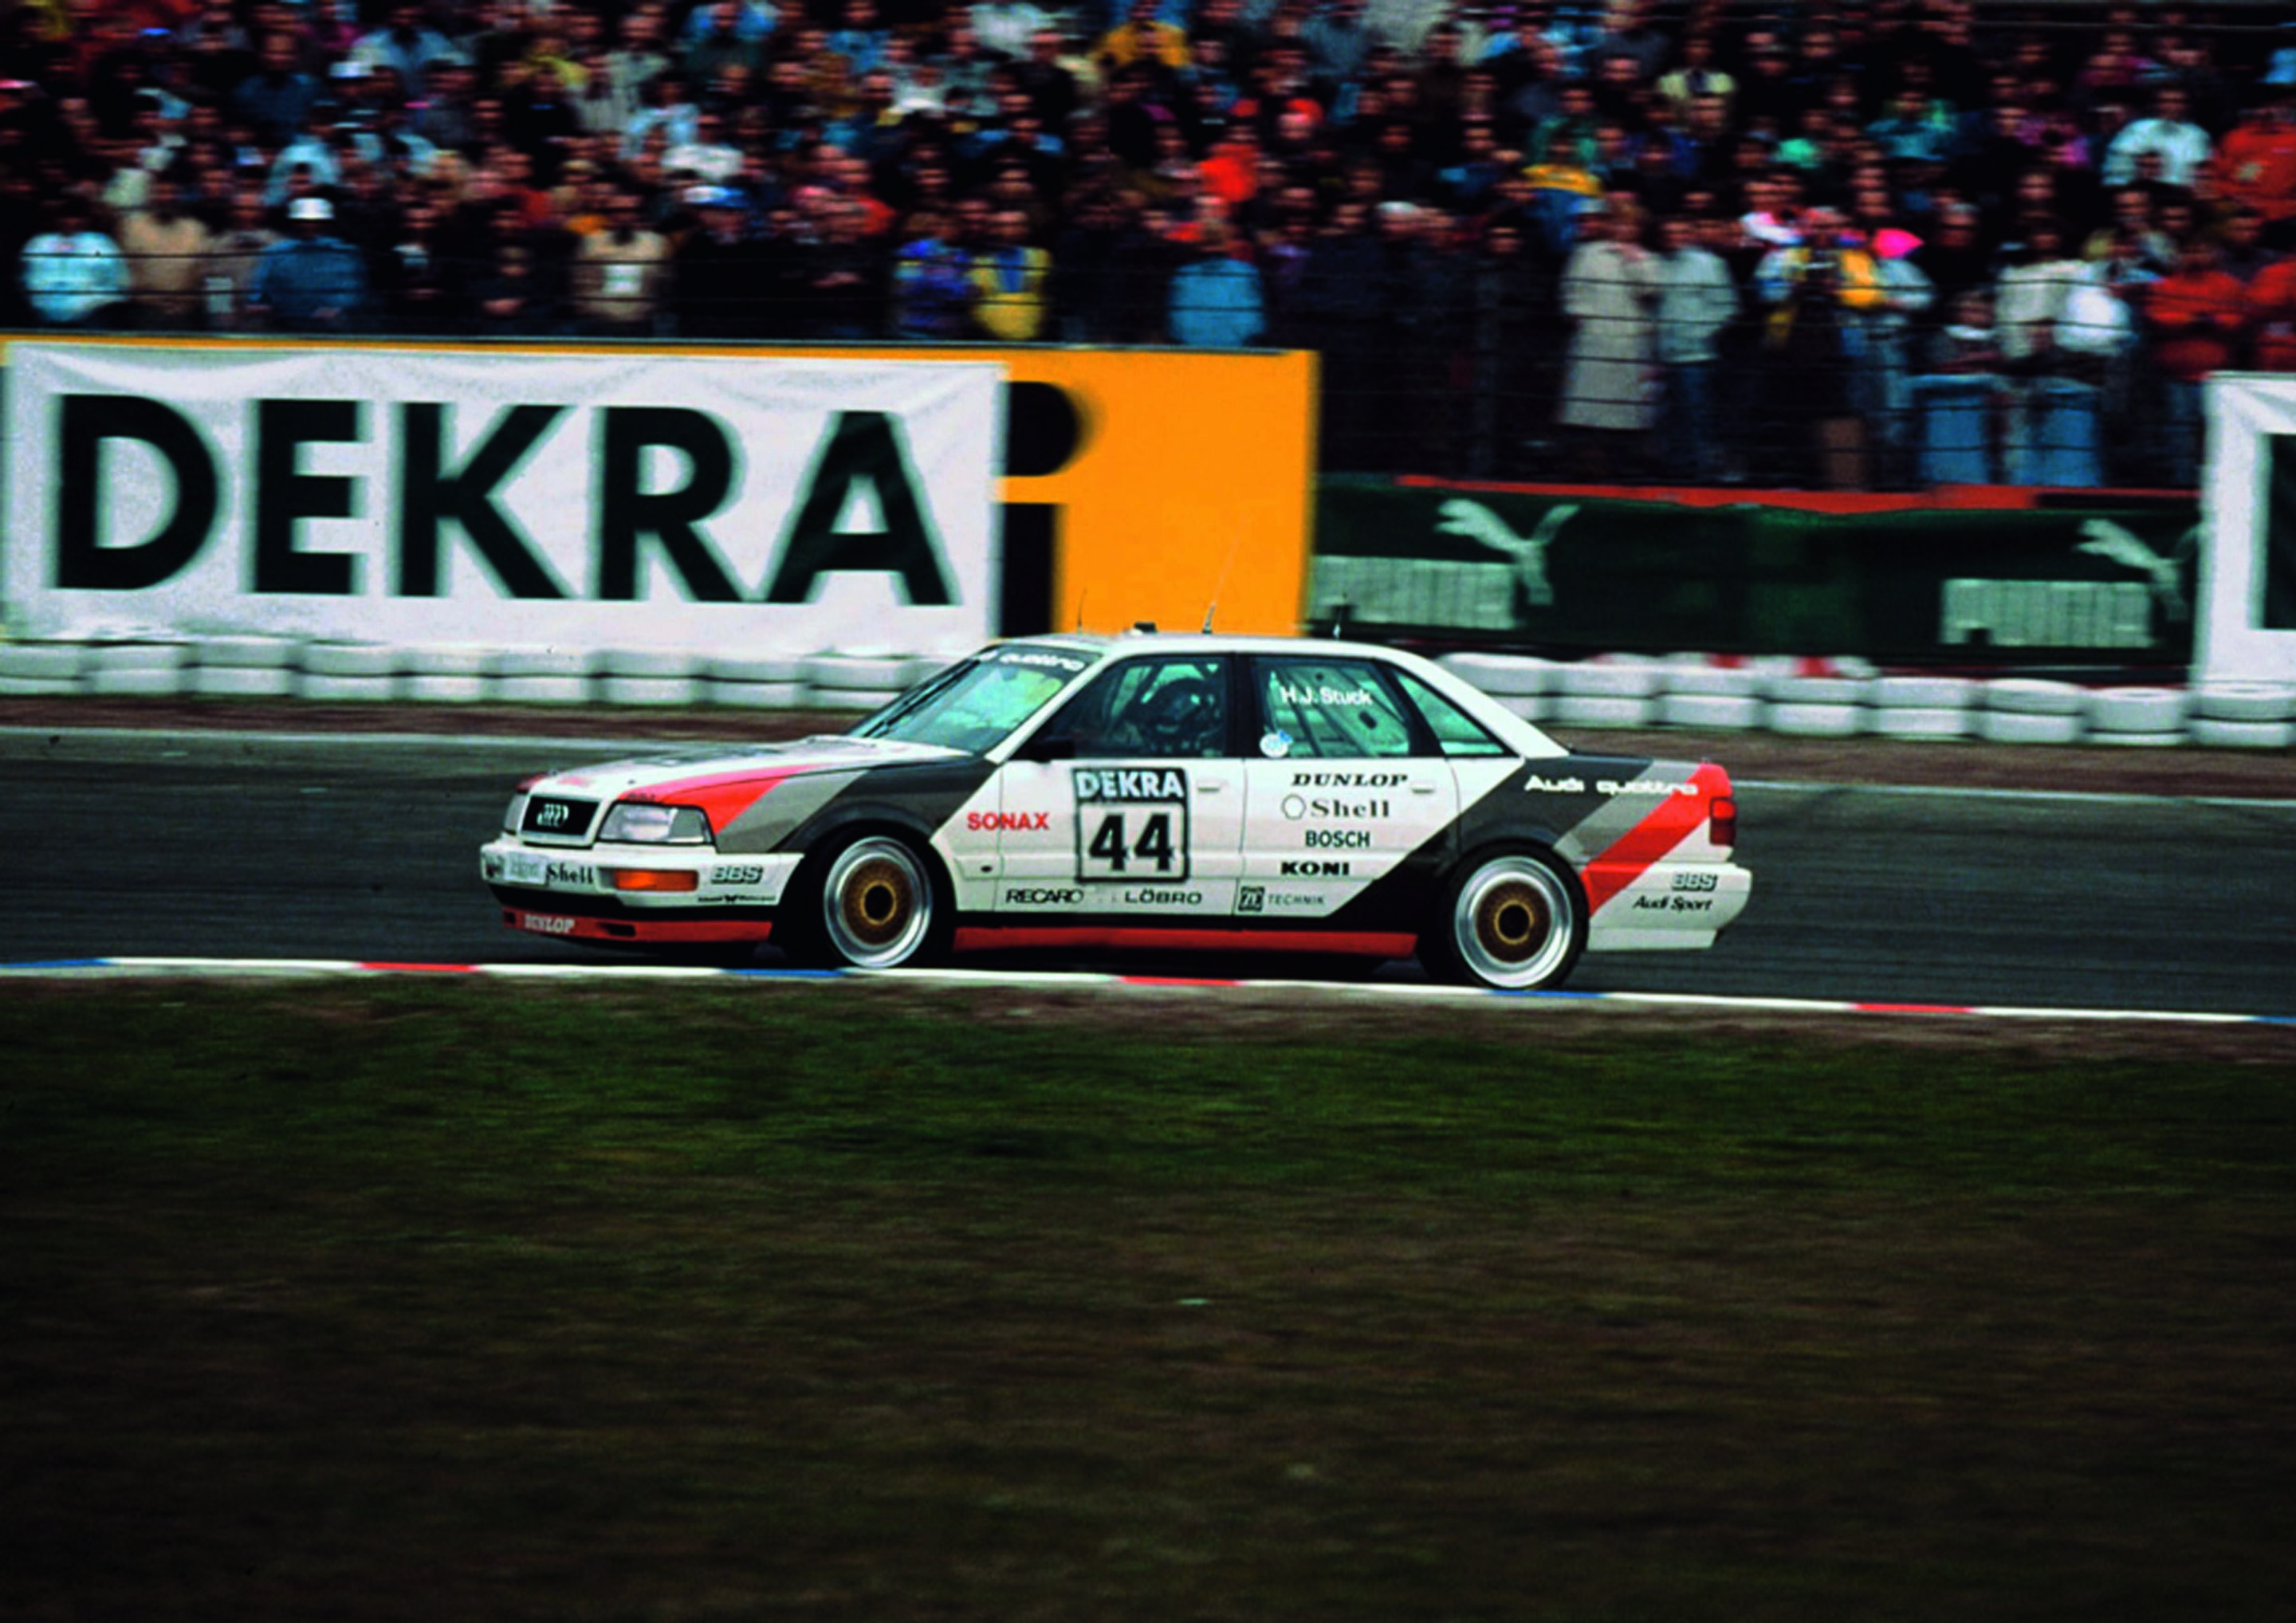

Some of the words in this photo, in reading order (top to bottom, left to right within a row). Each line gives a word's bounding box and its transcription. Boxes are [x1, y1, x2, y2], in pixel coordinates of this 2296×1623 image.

[52, 393, 961, 607] DEKRA
[1319, 687, 1374, 705] Stuck
[1075, 771, 1185, 798] DEKRA
[1291, 773, 1408, 787] DUNLOP
[1523, 774, 1586, 792] Audi
[1595, 780, 1700, 796] quattro
[1311, 800, 1390, 818] Shell
[967, 812, 1051, 831] SONAX
[1087, 812, 1176, 872] 44
[1305, 831, 1370, 847] BOSCH
[546, 861, 593, 885] Shell
[1280, 862, 1350, 876] KONI
[1671, 874, 1718, 891] BBS
[1005, 889, 1084, 904] RECARO
[1124, 889, 1202, 904] LÖBRO
[1671, 896, 1713, 912] Sport
